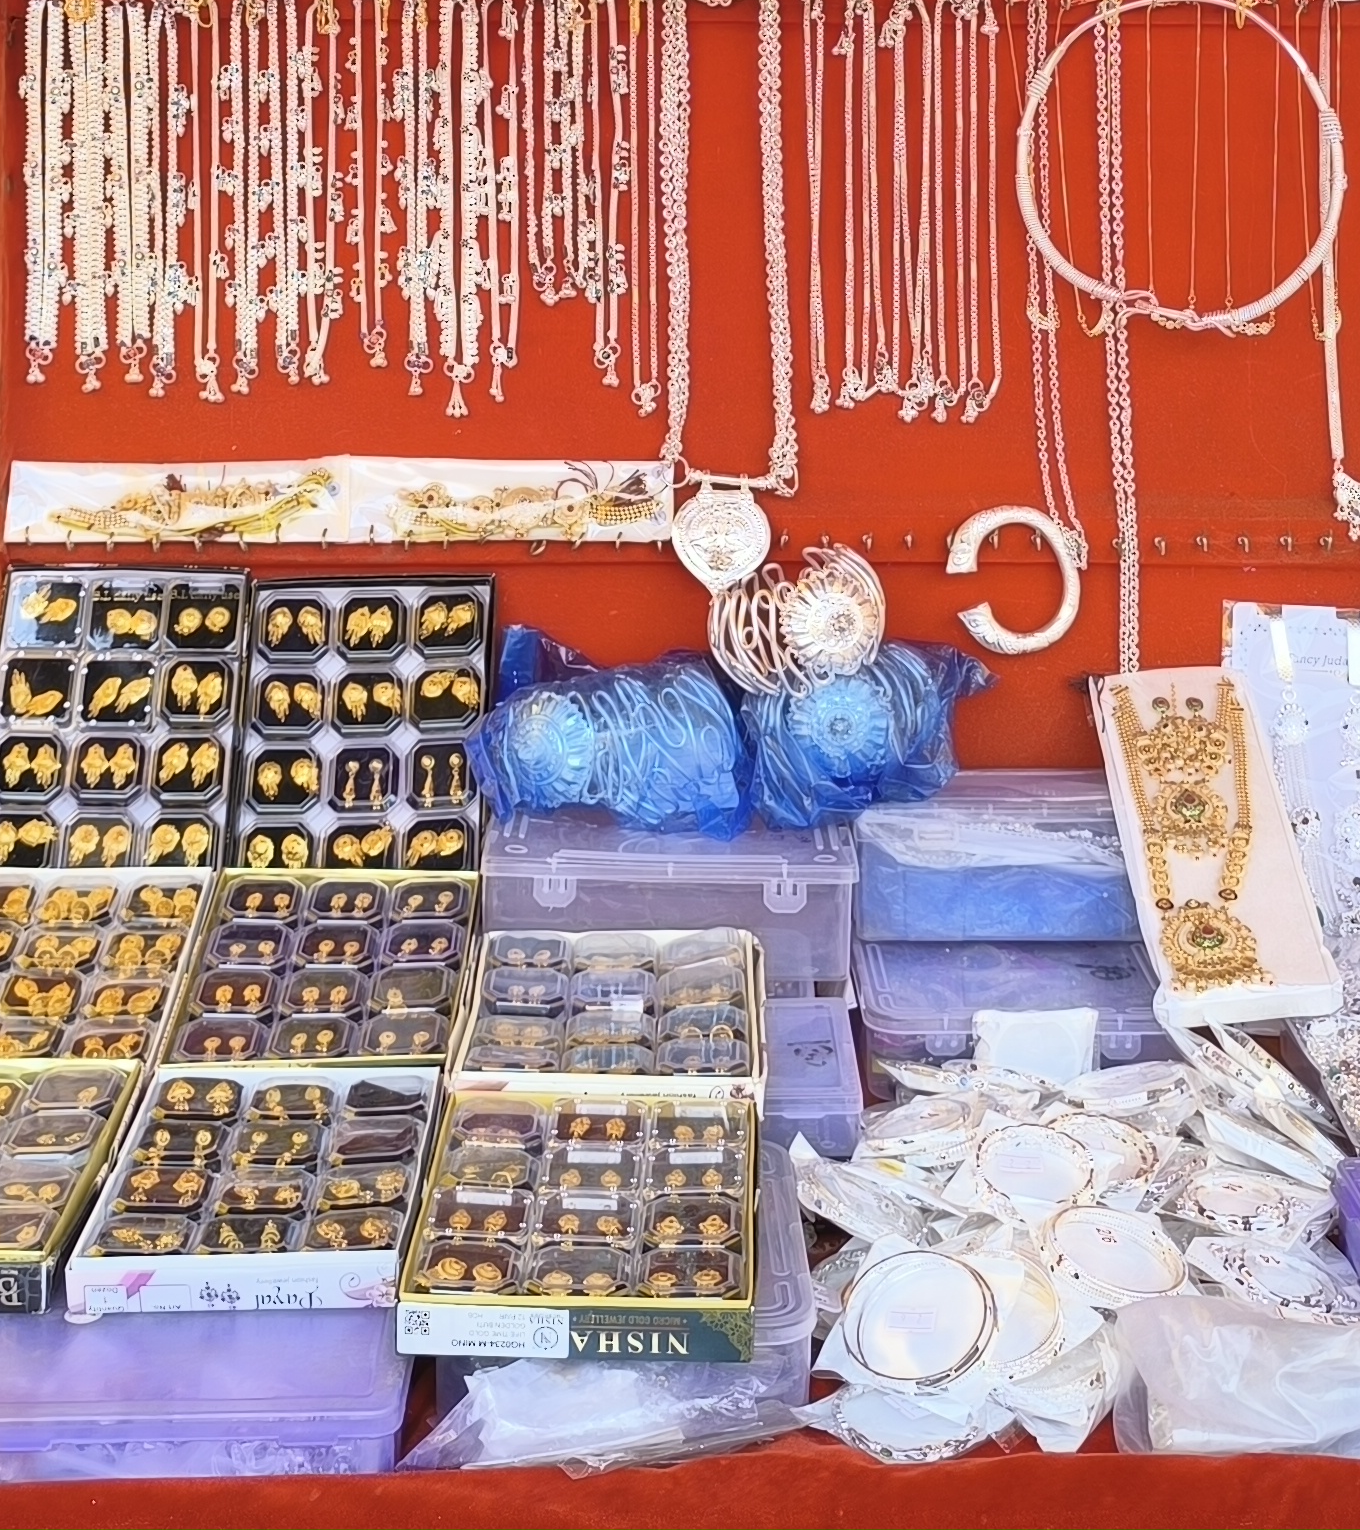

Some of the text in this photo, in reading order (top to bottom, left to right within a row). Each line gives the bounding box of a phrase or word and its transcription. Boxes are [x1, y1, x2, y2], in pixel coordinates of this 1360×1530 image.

[255, 1286, 323, 1310] Payal
[578, 1313, 681, 1327] MICRO GOLD JEWELLERY
[569, 1329, 690, 1356] NISHA
